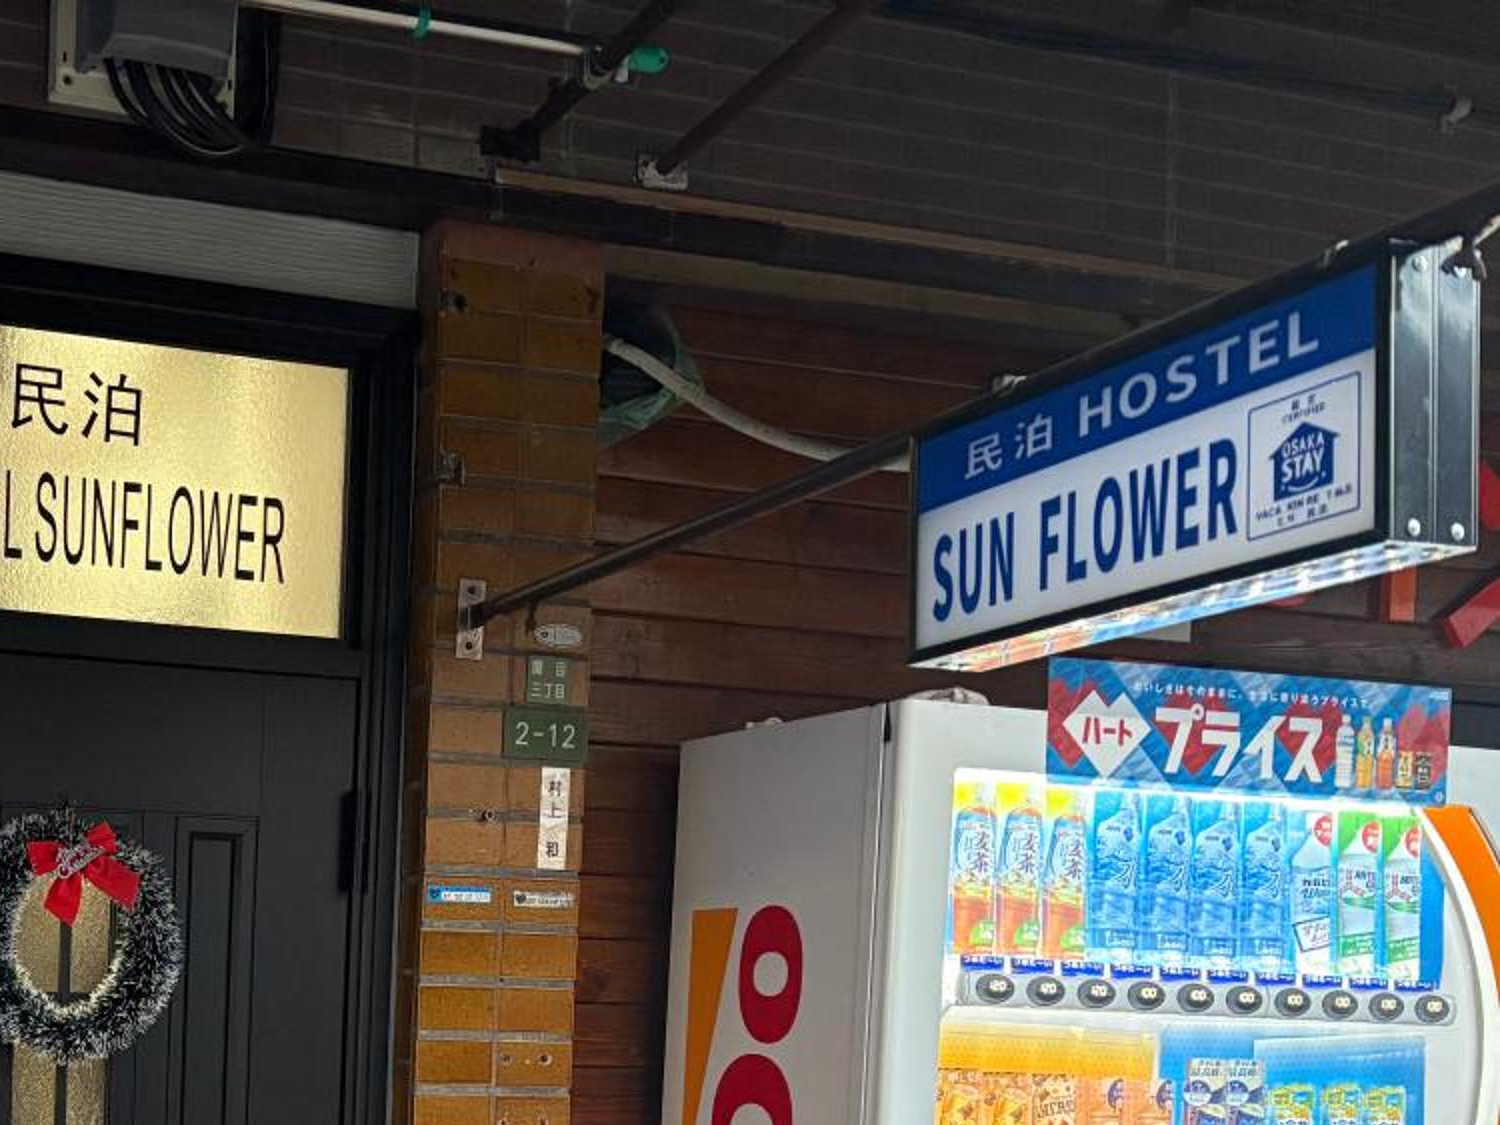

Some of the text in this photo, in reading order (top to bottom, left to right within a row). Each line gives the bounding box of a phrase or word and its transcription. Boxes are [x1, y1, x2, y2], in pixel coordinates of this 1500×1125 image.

[11, 363, 142, 447] 民泊
[965, 310, 1319, 480] 民泊 HOSTEL
[1282, 432, 1325, 457] OSAKA
[1282, 448, 1325, 483] STAY
[35, 471, 286, 585] SUNFLOWER
[932, 437, 1238, 623] SUN FLOWER
[515, 721, 576, 750] 2-12
[1082, 703, 1323, 783] ハート プライス
[972, 831, 990, 873] 麦茶
[1019, 832, 1038, 874] 麦茶
[1066, 837, 1084, 880] 麦茶
